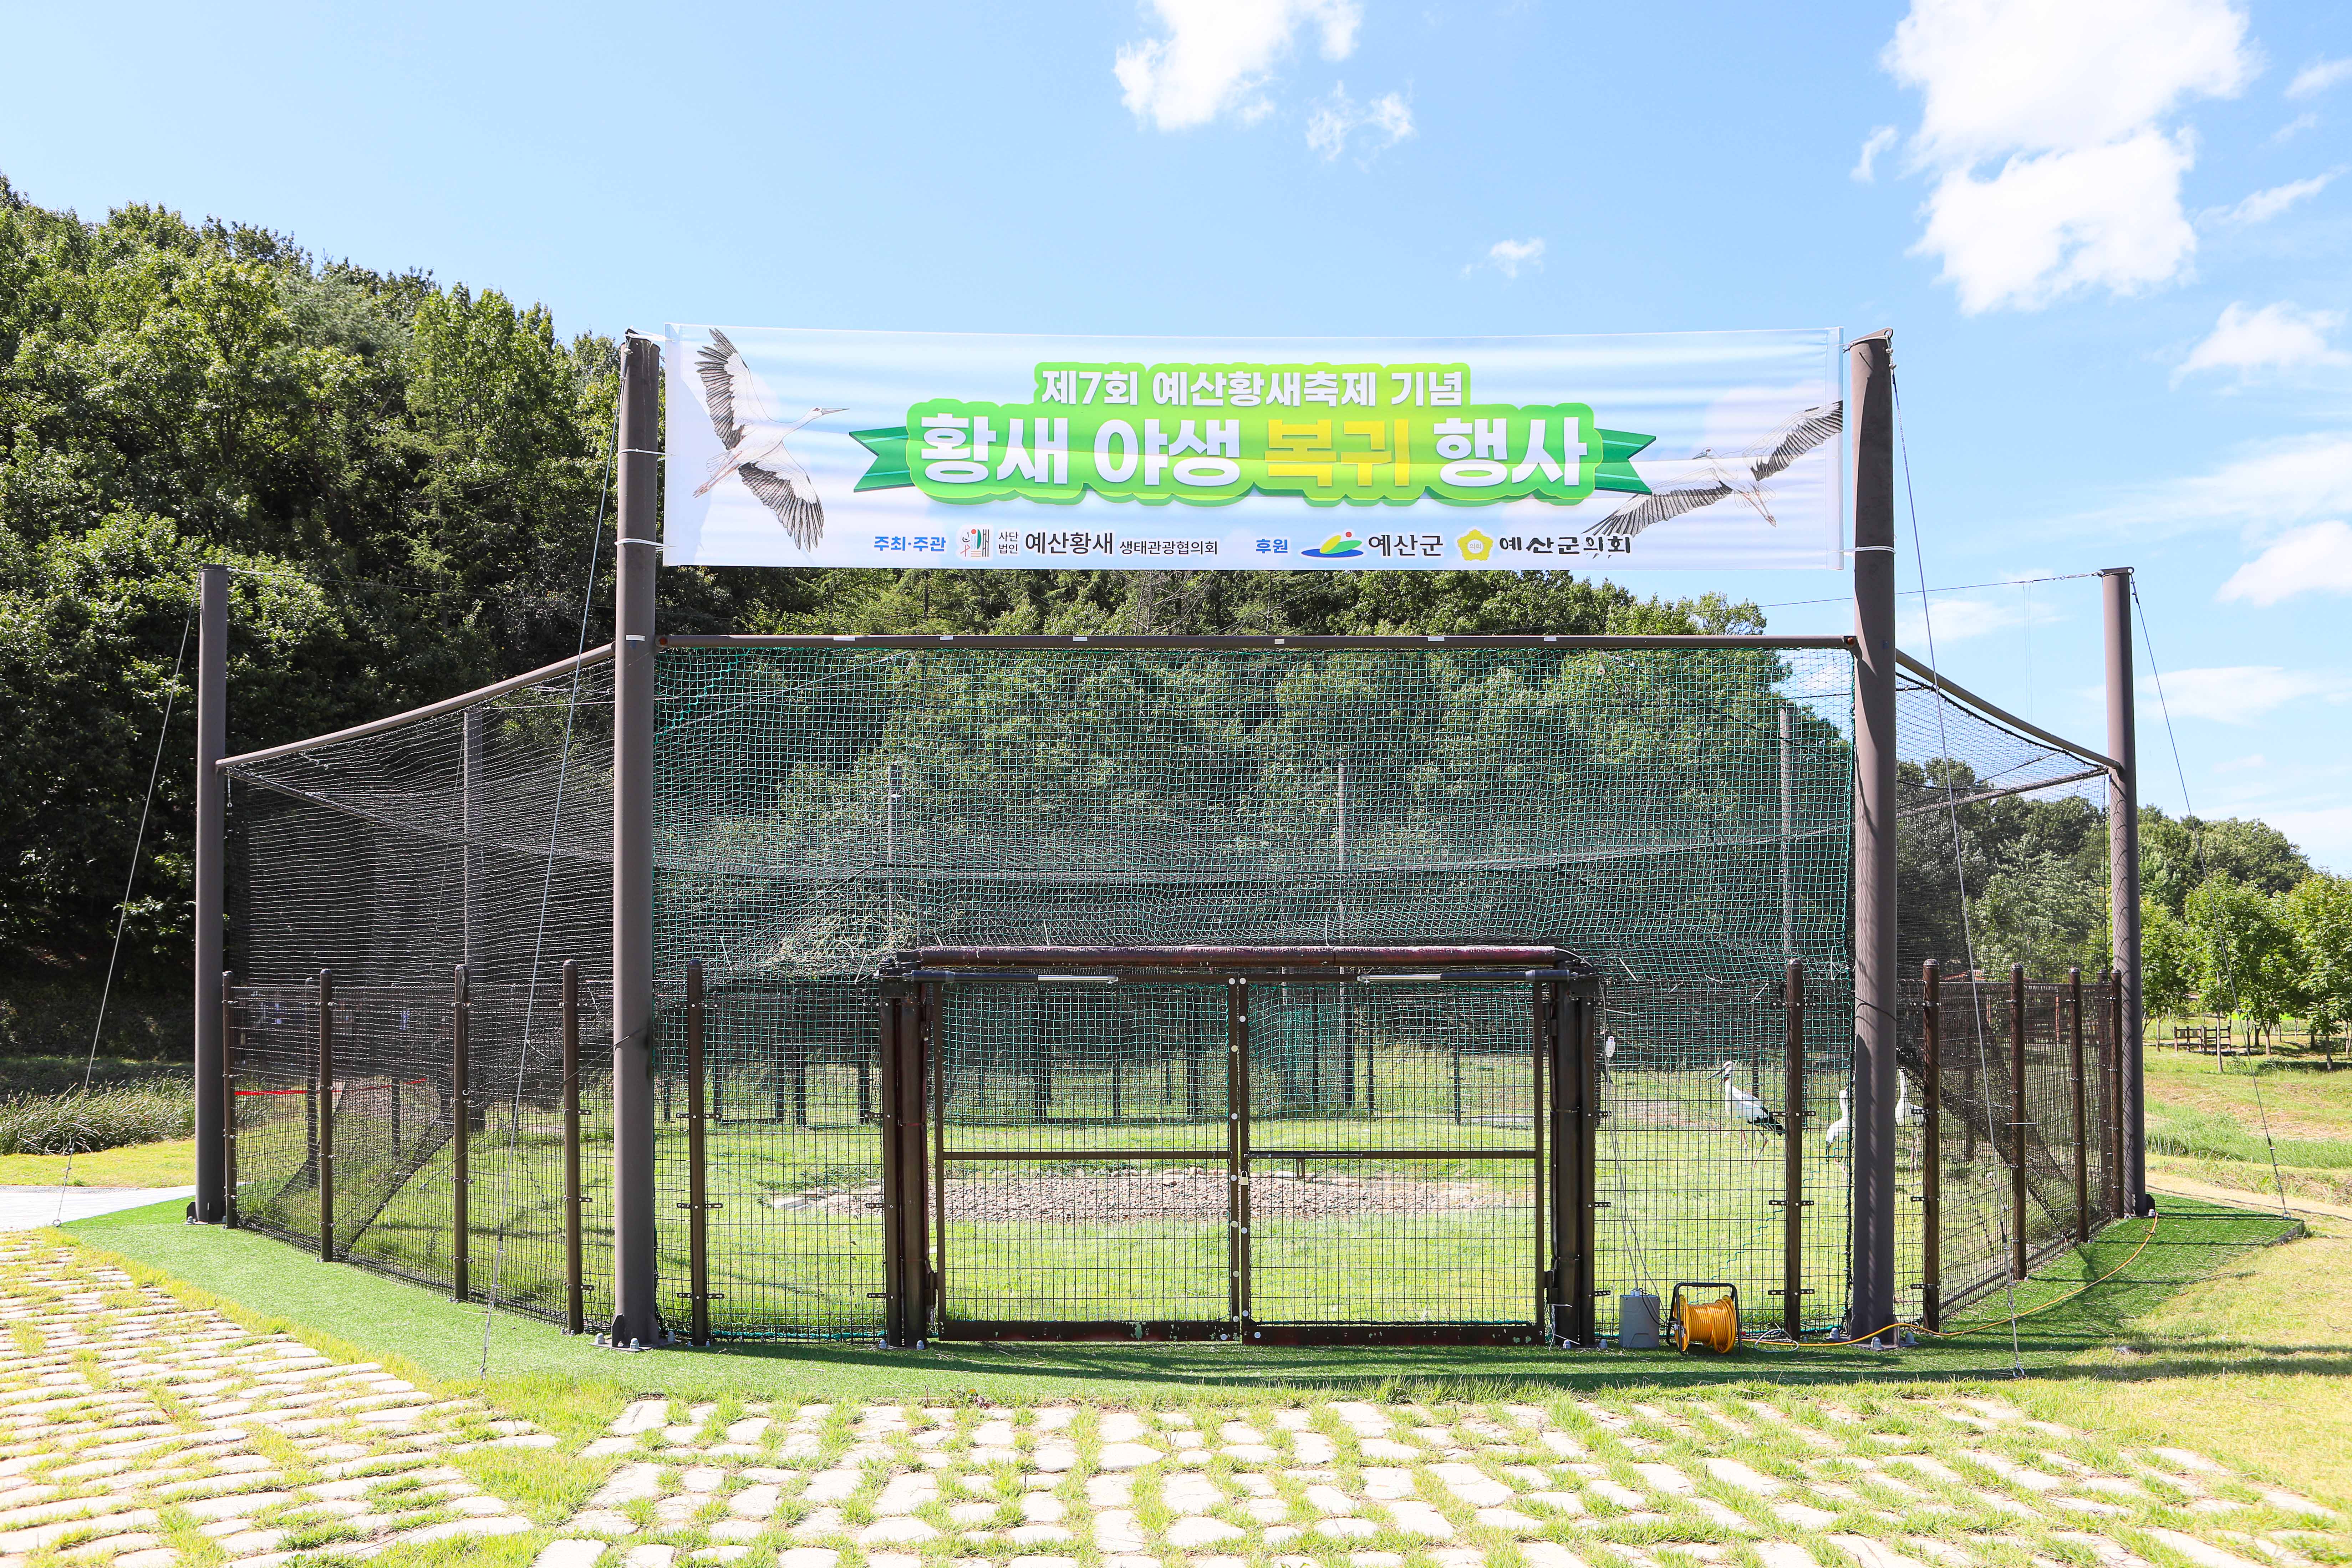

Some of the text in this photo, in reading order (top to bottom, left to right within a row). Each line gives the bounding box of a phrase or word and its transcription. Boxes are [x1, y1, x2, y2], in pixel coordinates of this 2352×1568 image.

[1042, 371, 1462, 407] 제7회 예산황새축제 기념
[921, 413, 1587, 487] 황새 야생 복귀 행사
[874, 536, 946, 552] 주최·주관
[998, 531, 1019, 541] 사단
[1025, 532, 1217, 554] 예산황새 생태관광협의회
[1500, 536, 1630, 554] 예산군의회
[998, 544, 1018, 554] 법인
[1256, 539, 1288, 554] 후원
[1368, 535, 1443, 556] 예산군
